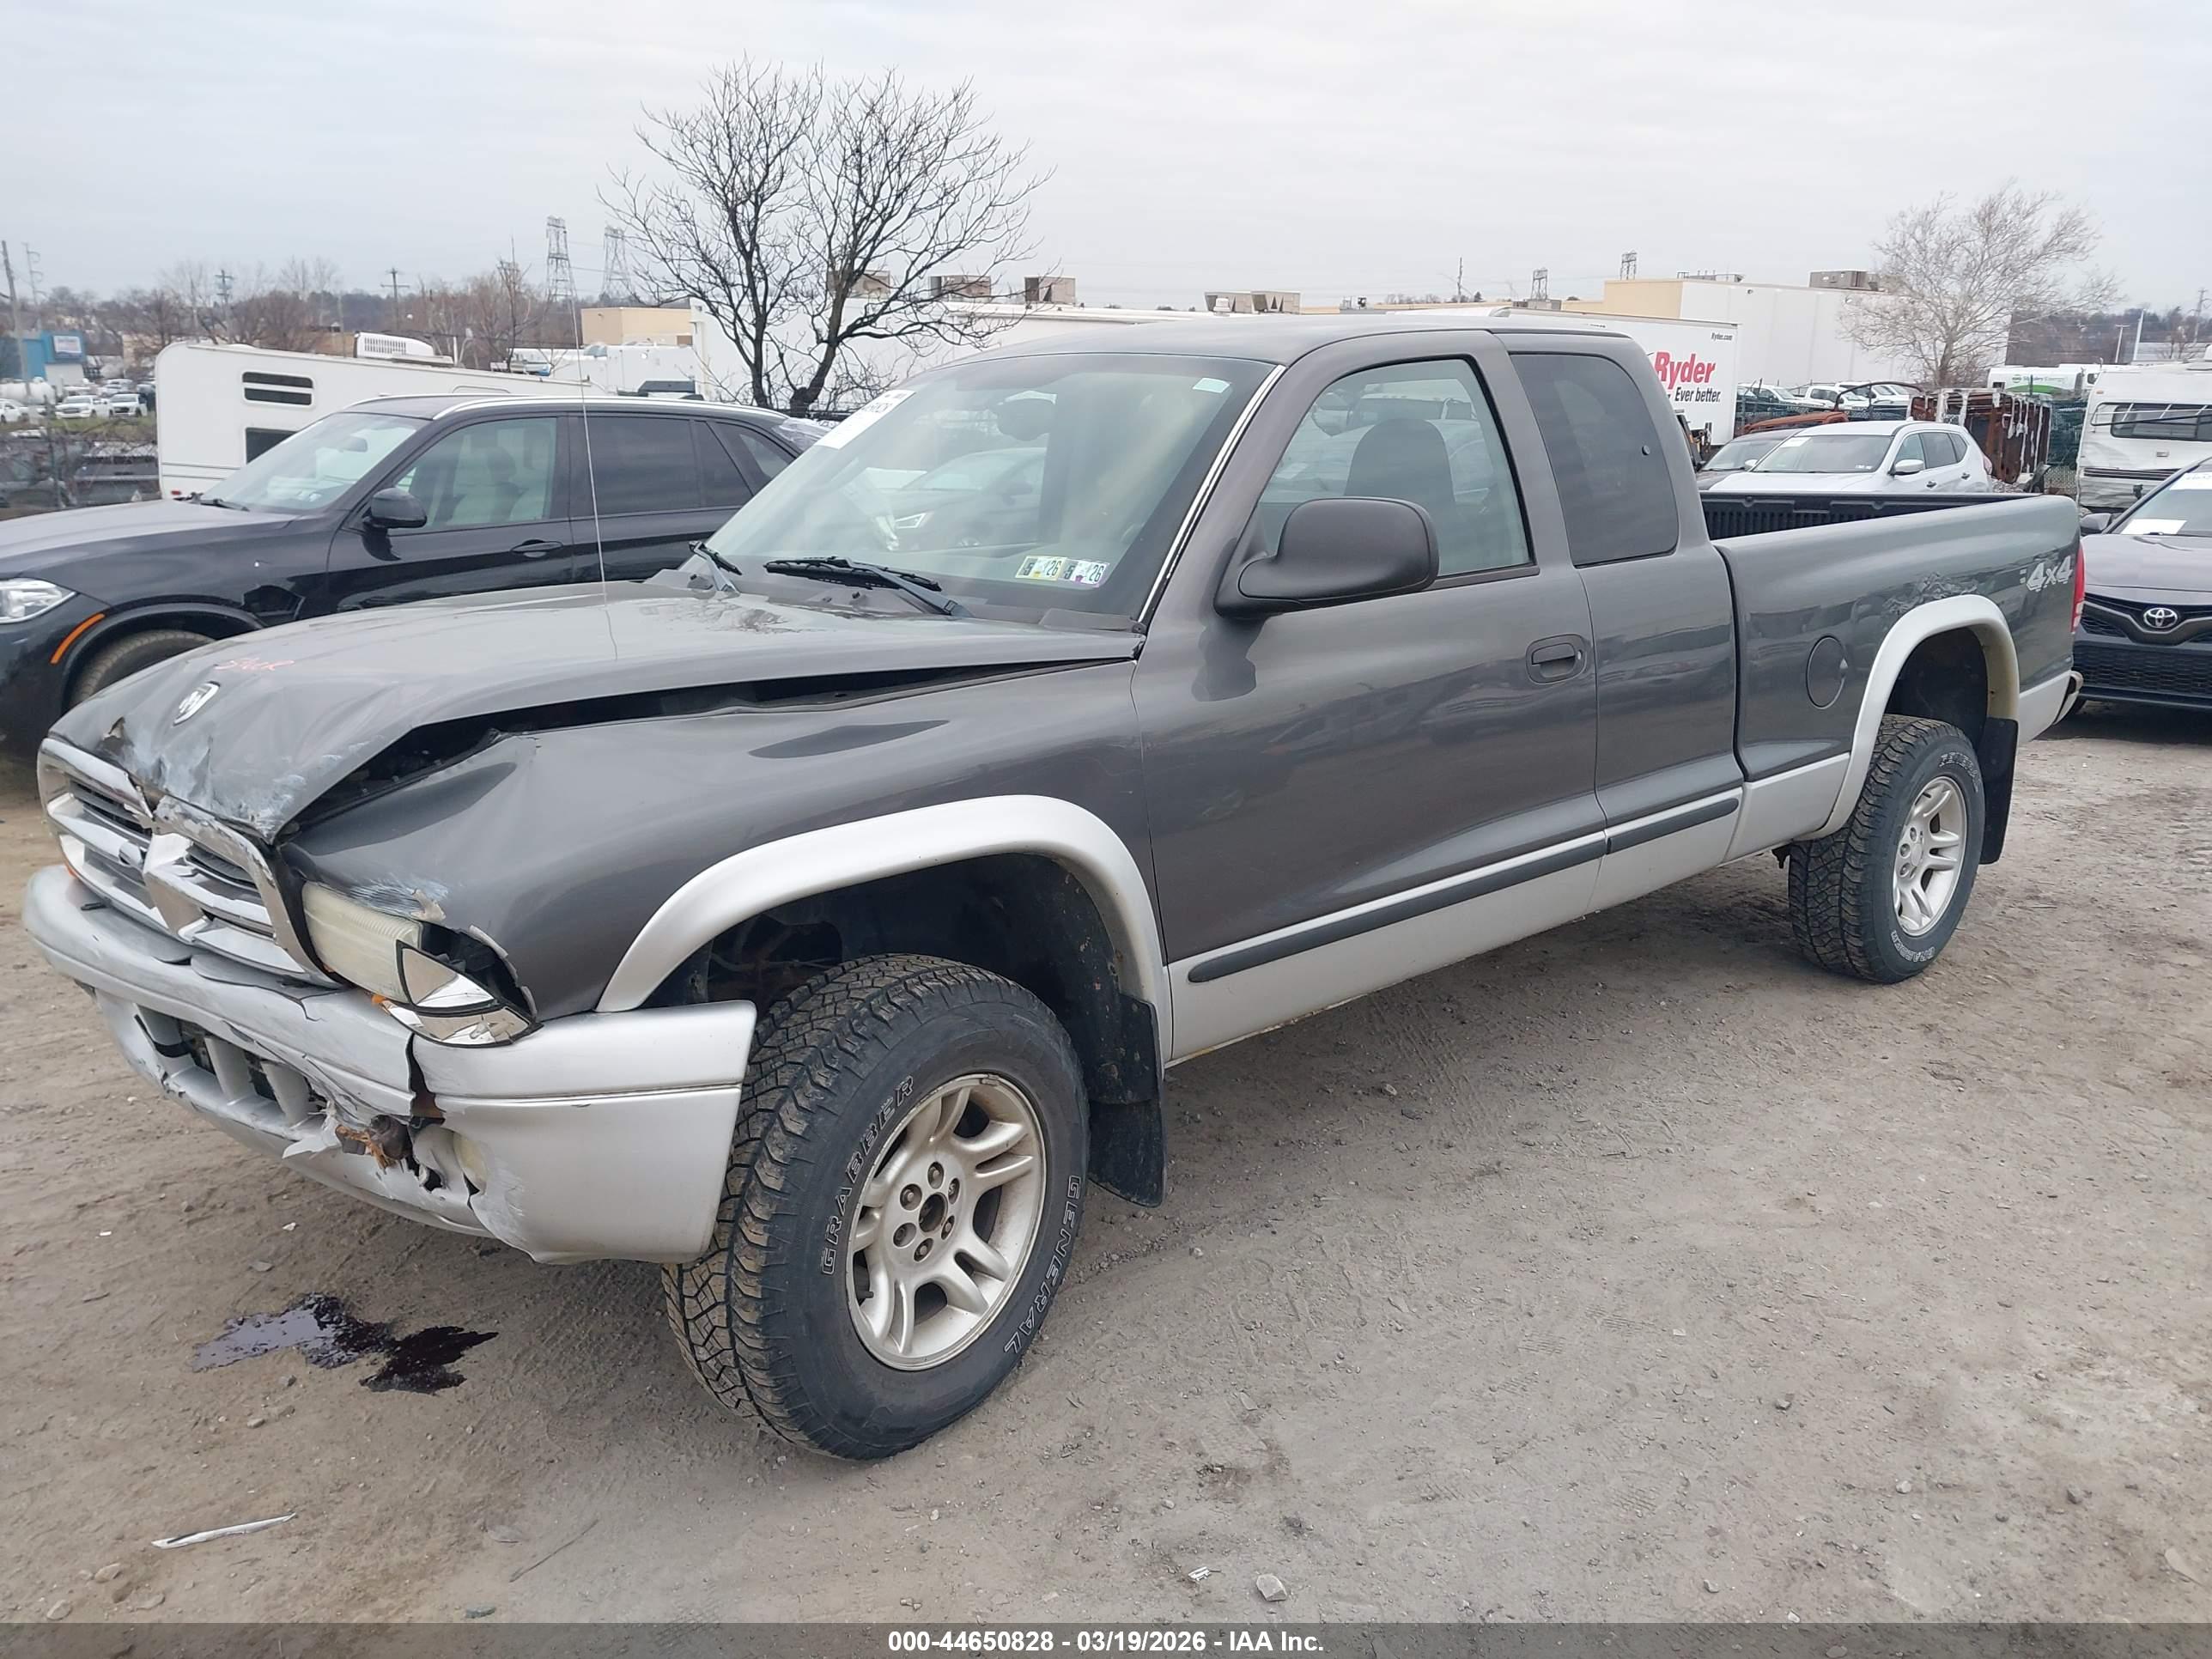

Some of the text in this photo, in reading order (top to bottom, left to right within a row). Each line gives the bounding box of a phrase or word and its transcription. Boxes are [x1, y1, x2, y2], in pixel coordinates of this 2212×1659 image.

[1655, 351, 1717, 389] Ryder
[1675, 386, 1721, 403] Ever better.
[1046, 560, 1062, 576] 26
[1064, 564, 1104, 582] 5 26
[2027, 556, 2073, 592] 4x4
[820, 1075, 914, 1275] GRABBER
[1004, 1175, 1081, 1354] GENERAL
